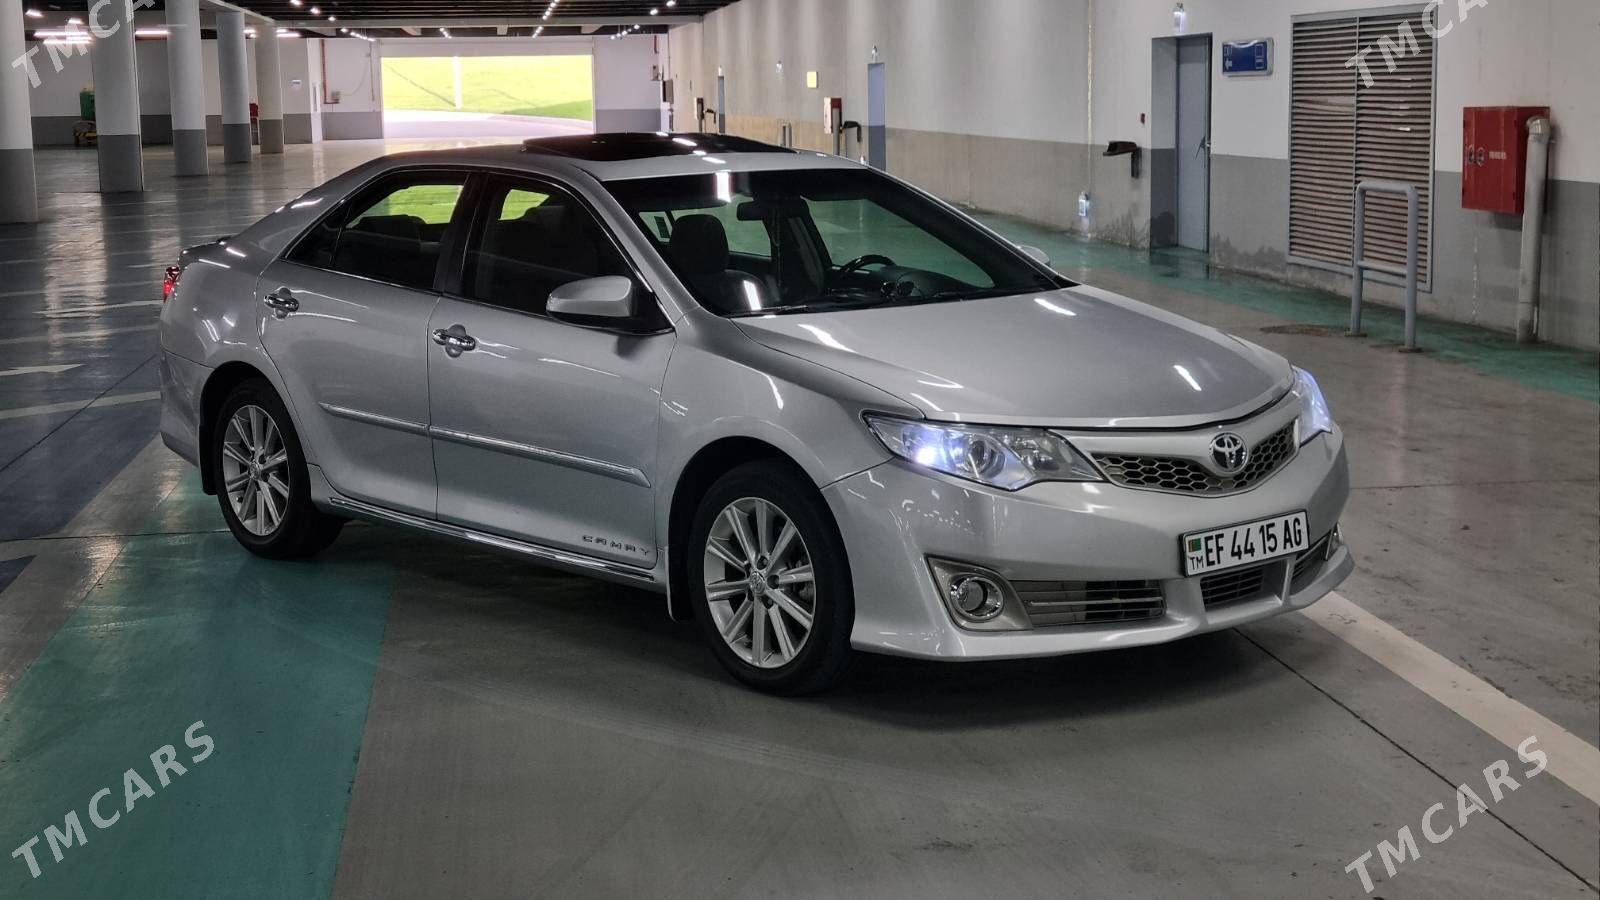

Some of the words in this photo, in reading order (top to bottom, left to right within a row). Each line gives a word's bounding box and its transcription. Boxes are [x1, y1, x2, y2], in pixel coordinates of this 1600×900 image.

[1204, 533, 1225, 567] EF
[1231, 528, 1256, 560] 44
[1259, 522, 1278, 554] 15
[1283, 517, 1302, 550] AG
[1190, 556, 1204, 570] TM
